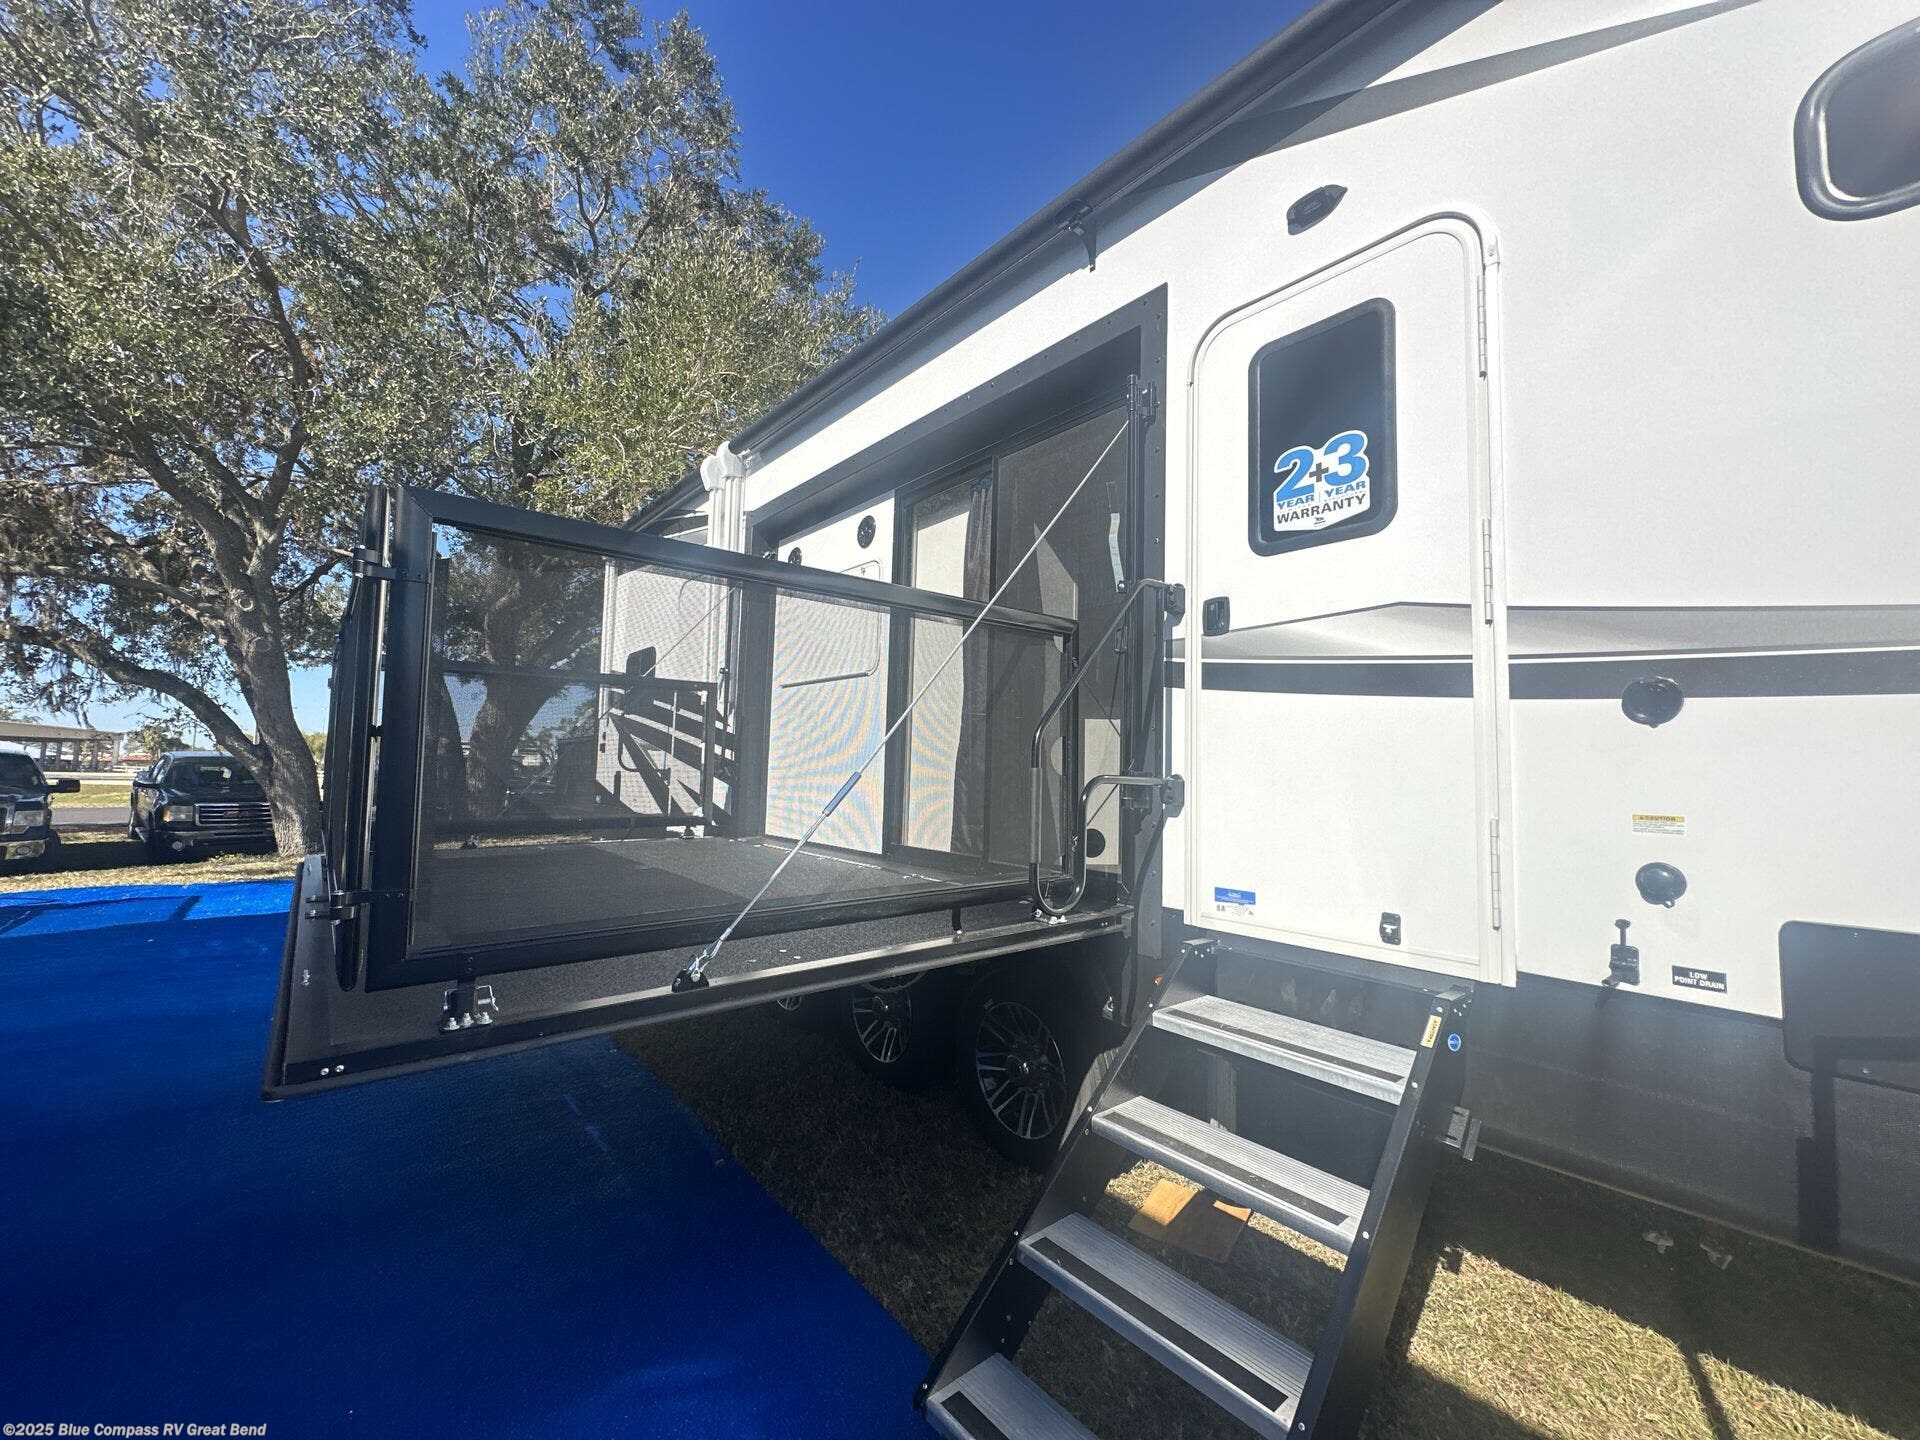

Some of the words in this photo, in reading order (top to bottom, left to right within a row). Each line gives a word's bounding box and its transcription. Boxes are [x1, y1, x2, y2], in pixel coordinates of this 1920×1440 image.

[1277, 494, 1315, 510] YEAR
[1324, 481, 1366, 498] YEAR
[1277, 493, 1366, 524] WARRANTY
[1674, 975, 1698, 986] POINT
[1699, 980, 1725, 990] DRAIN
[1689, 971, 1708, 980] LOW
